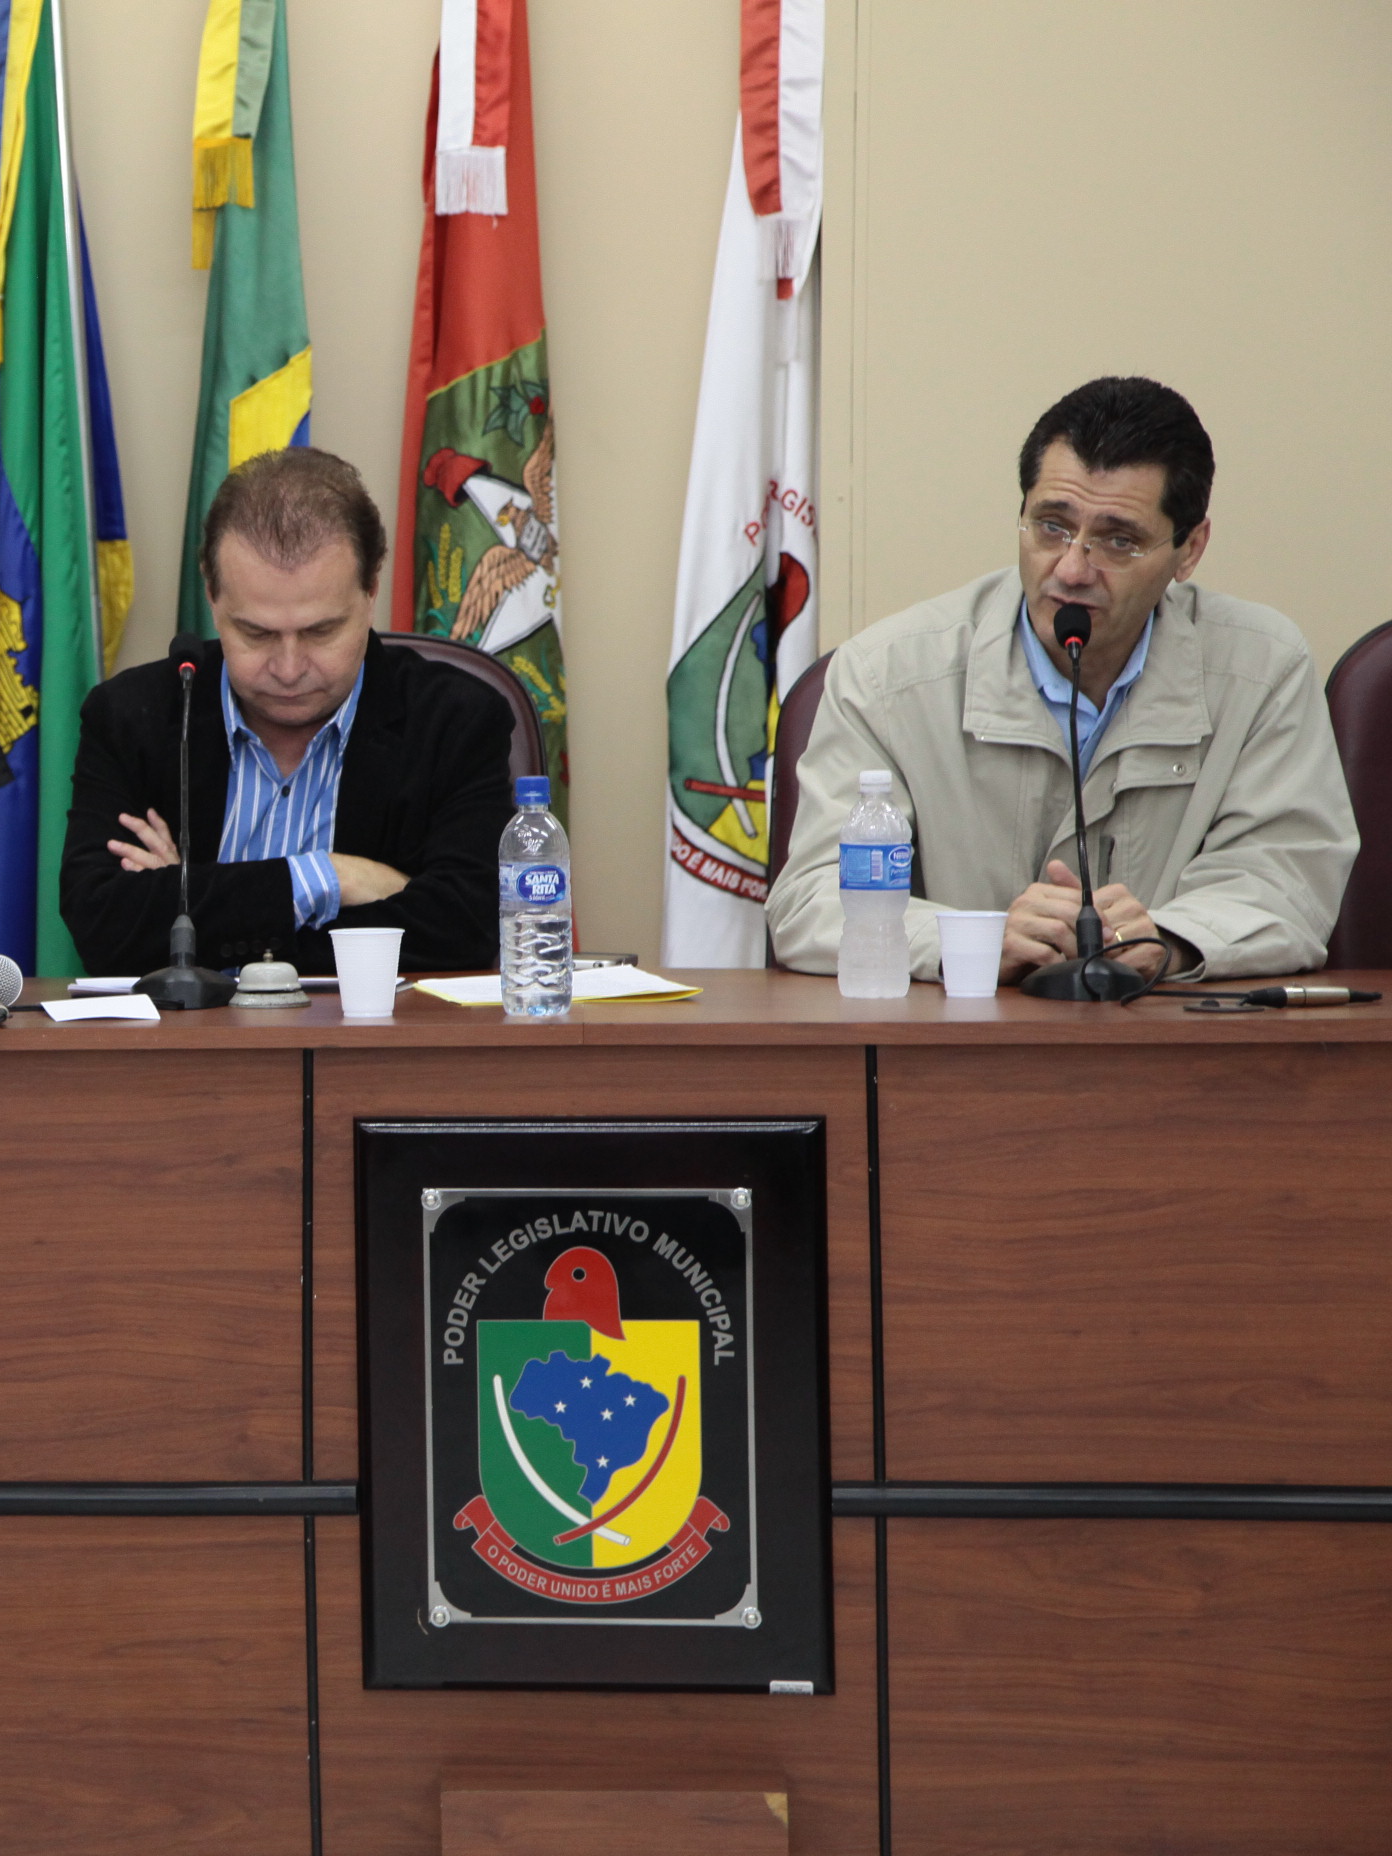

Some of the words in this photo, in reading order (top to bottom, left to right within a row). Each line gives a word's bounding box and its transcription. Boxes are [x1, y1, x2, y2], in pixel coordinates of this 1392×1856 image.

[525, 873, 559, 885] SANTA
[532, 883, 556, 895] RITA
[443, 1272, 487, 1365] PODER
[478, 1210, 650, 1274] LEGISLATIVO
[652, 1233, 736, 1366] MUNICIPAL
[486, 1544, 500, 1559] O
[498, 1554, 548, 1592] PODER
[550, 1579, 599, 1599] UNIDO
[601, 1581, 612, 1599] É
[614, 1574, 653, 1598] MAIS
[652, 1542, 700, 1586] FORTE
